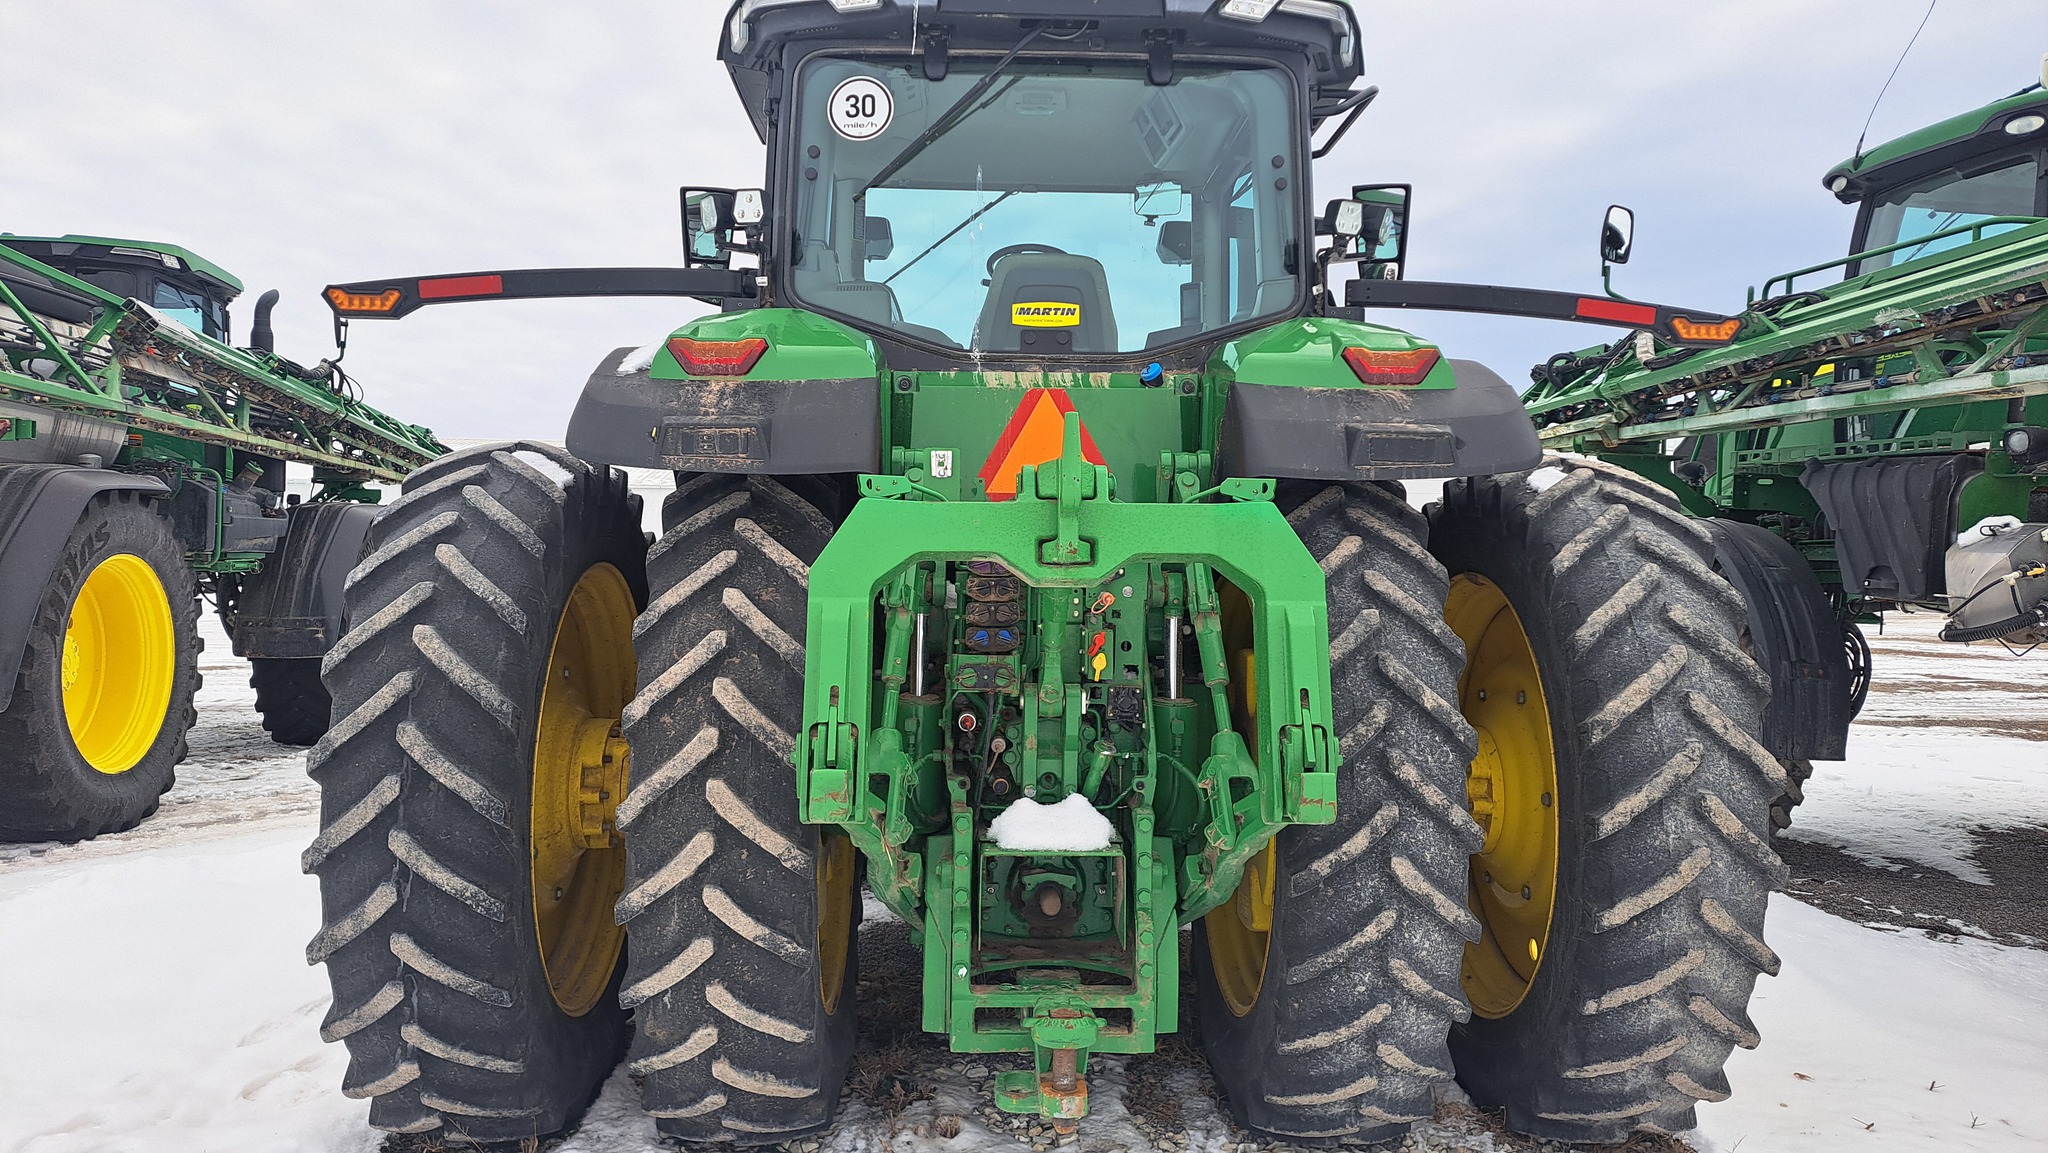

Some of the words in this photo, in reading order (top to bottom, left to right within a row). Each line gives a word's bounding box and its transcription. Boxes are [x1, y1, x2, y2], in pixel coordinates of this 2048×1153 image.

[845, 93, 876, 118] 30
[843, 121, 878, 129] mile/h
[1018, 307, 1077, 316] MARTIN
